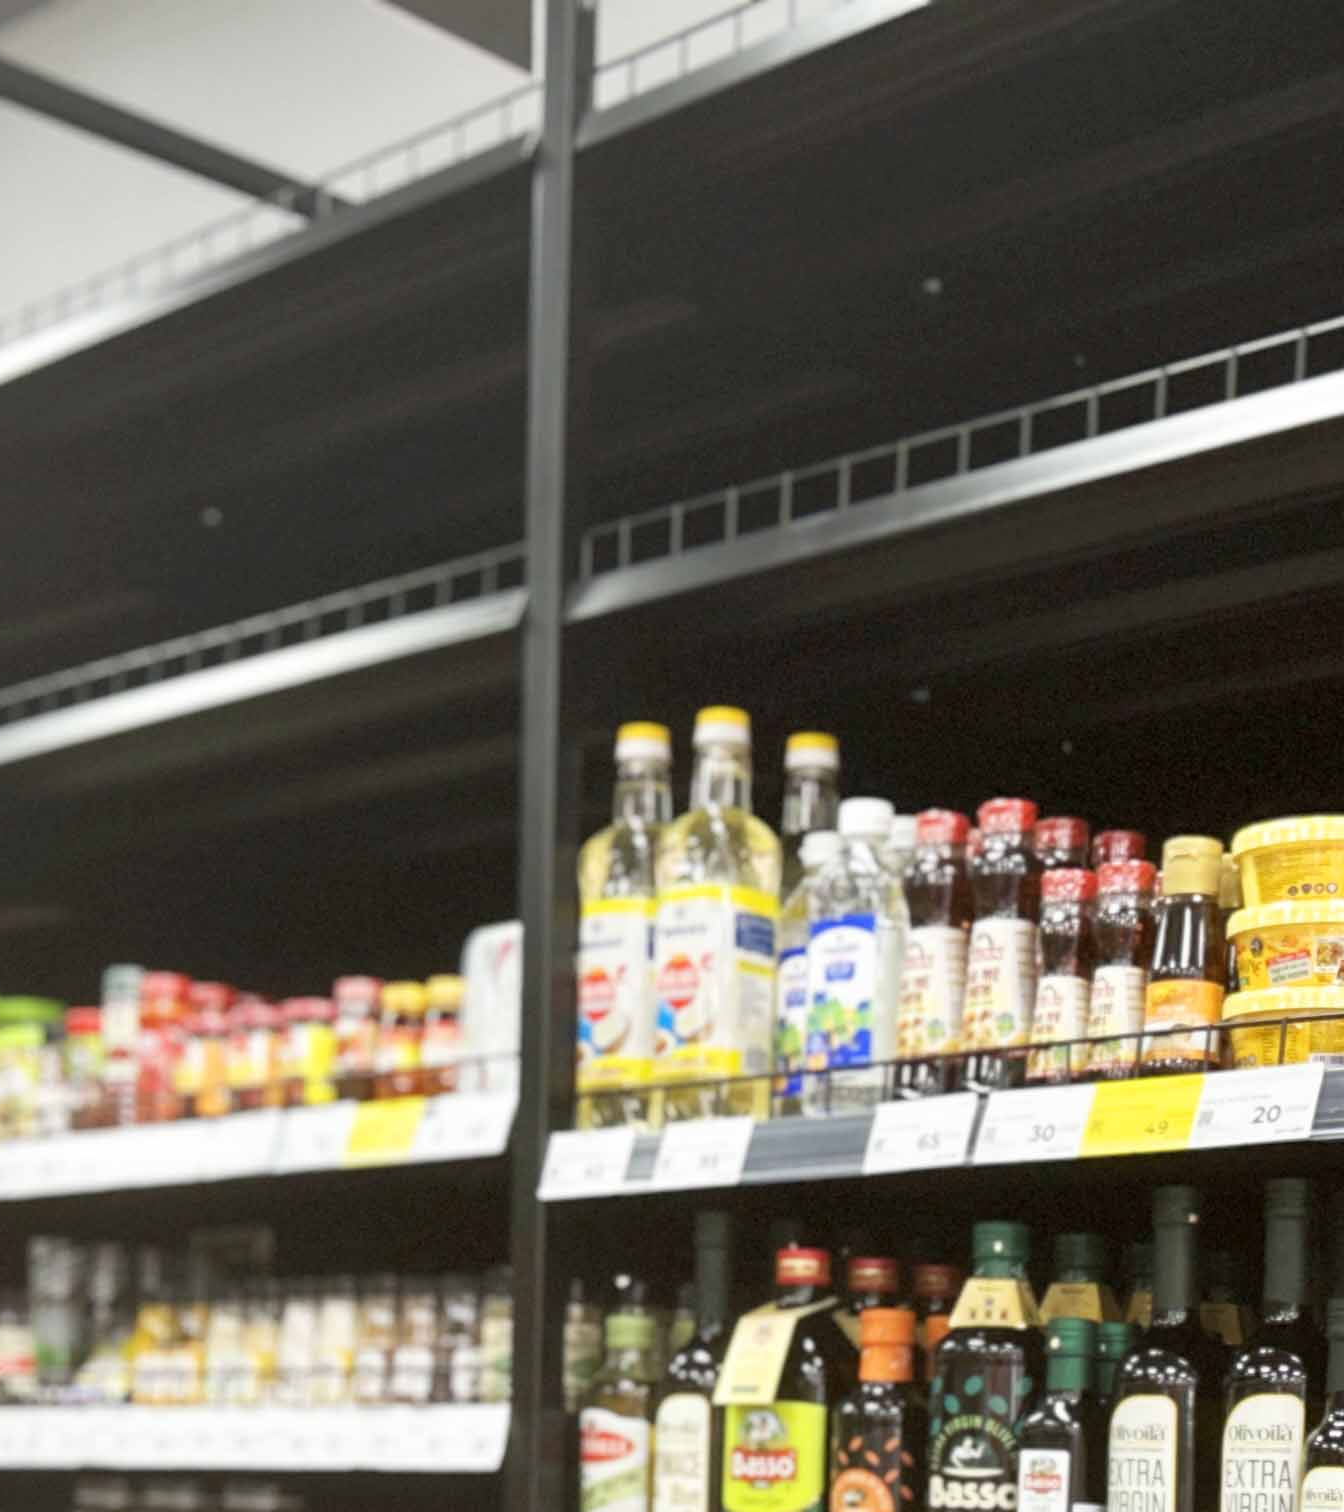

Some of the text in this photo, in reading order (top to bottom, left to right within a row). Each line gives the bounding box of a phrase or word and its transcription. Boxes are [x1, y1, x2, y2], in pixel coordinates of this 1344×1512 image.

[1252, 1104, 1283, 1124] 20
[1029, 1123, 1056, 1143] 30
[1108, 1458, 1164, 1489] EXTRA
[1224, 1458, 1293, 1490] EXTRA
[928, 1474, 1018, 1510] basso
